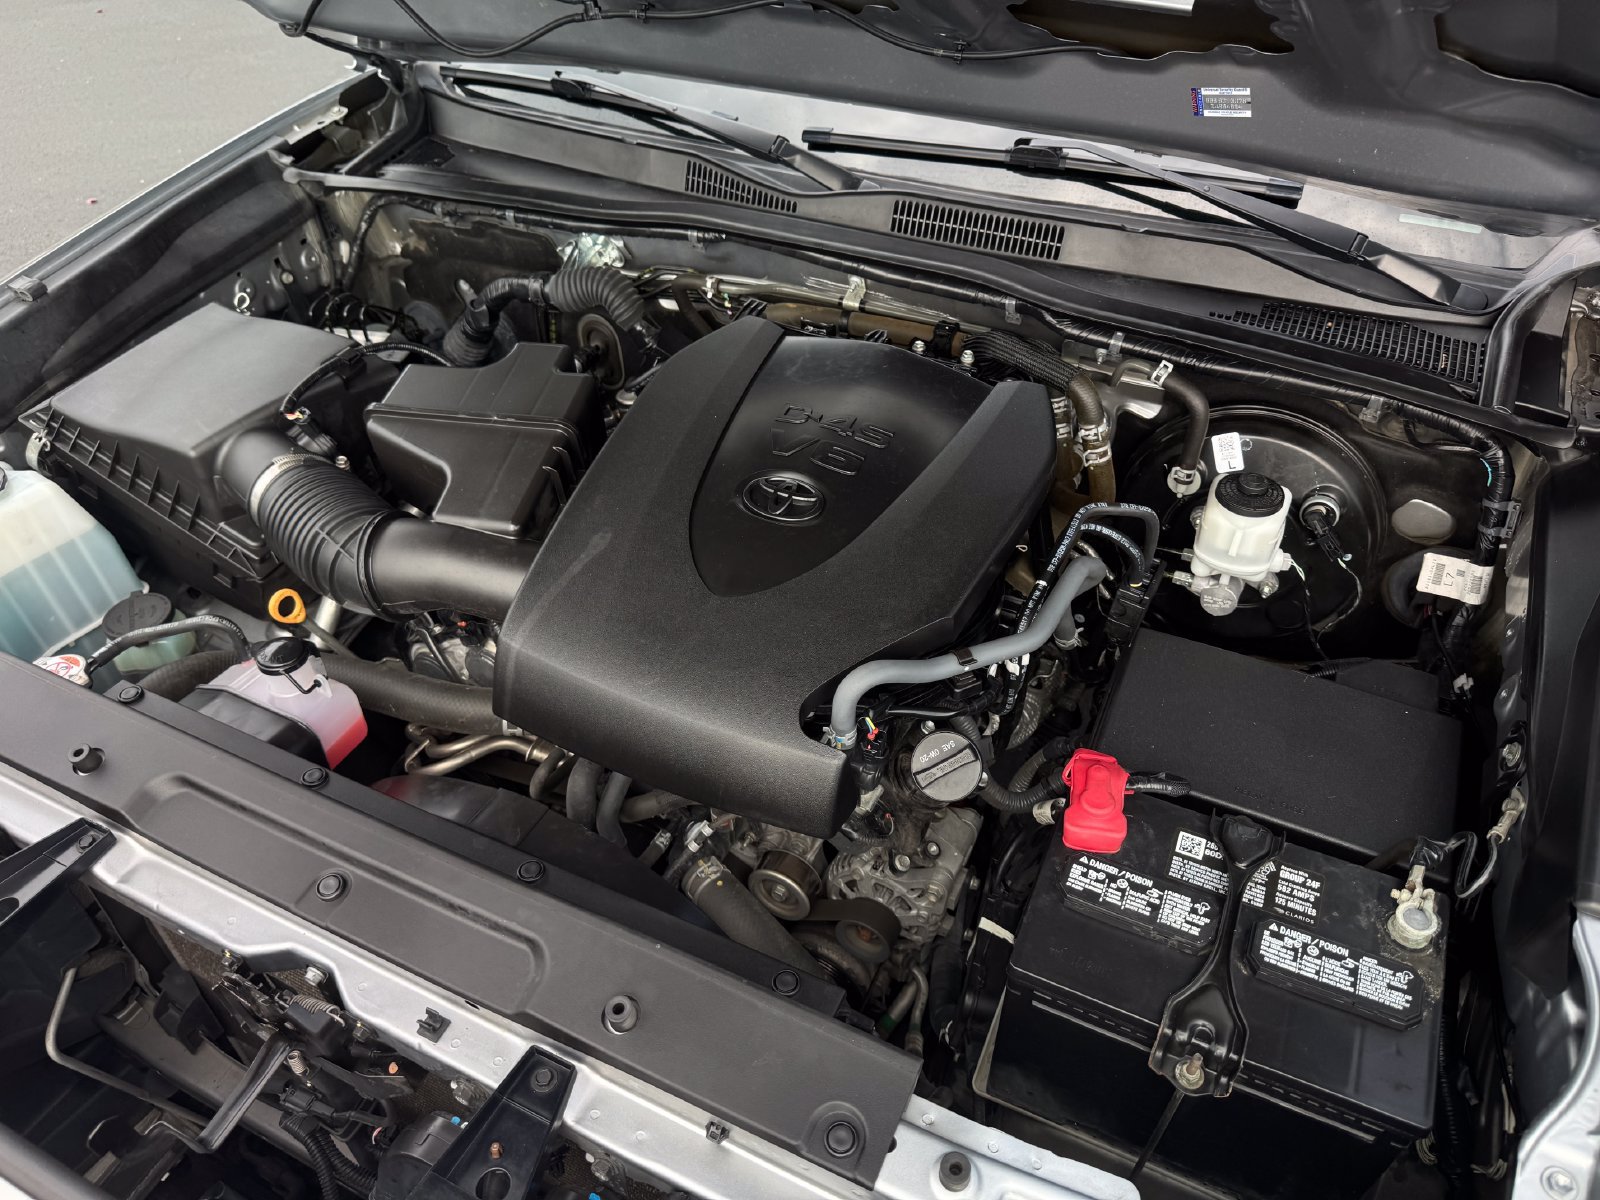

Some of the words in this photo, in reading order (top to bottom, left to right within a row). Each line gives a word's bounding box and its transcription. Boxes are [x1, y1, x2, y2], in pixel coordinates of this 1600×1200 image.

[770, 428, 866, 475] V6
[1228, 461, 1237, 470] L
[941, 740, 956, 752] SAE
[919, 748, 940, 763] 0W-20
[1278, 869, 1305, 884] GROUP
[1305, 878, 1321, 889] 24F
[1276, 884, 1291, 893] 582
[1292, 889, 1315, 901] AMPS
[1273, 897, 1286, 905] 125
[1286, 901, 1317, 916] MINUTES
[1284, 910, 1315, 924] CLARIOS
[1278, 925, 1312, 944] DANGER
[1318, 940, 1349, 957] POISON
